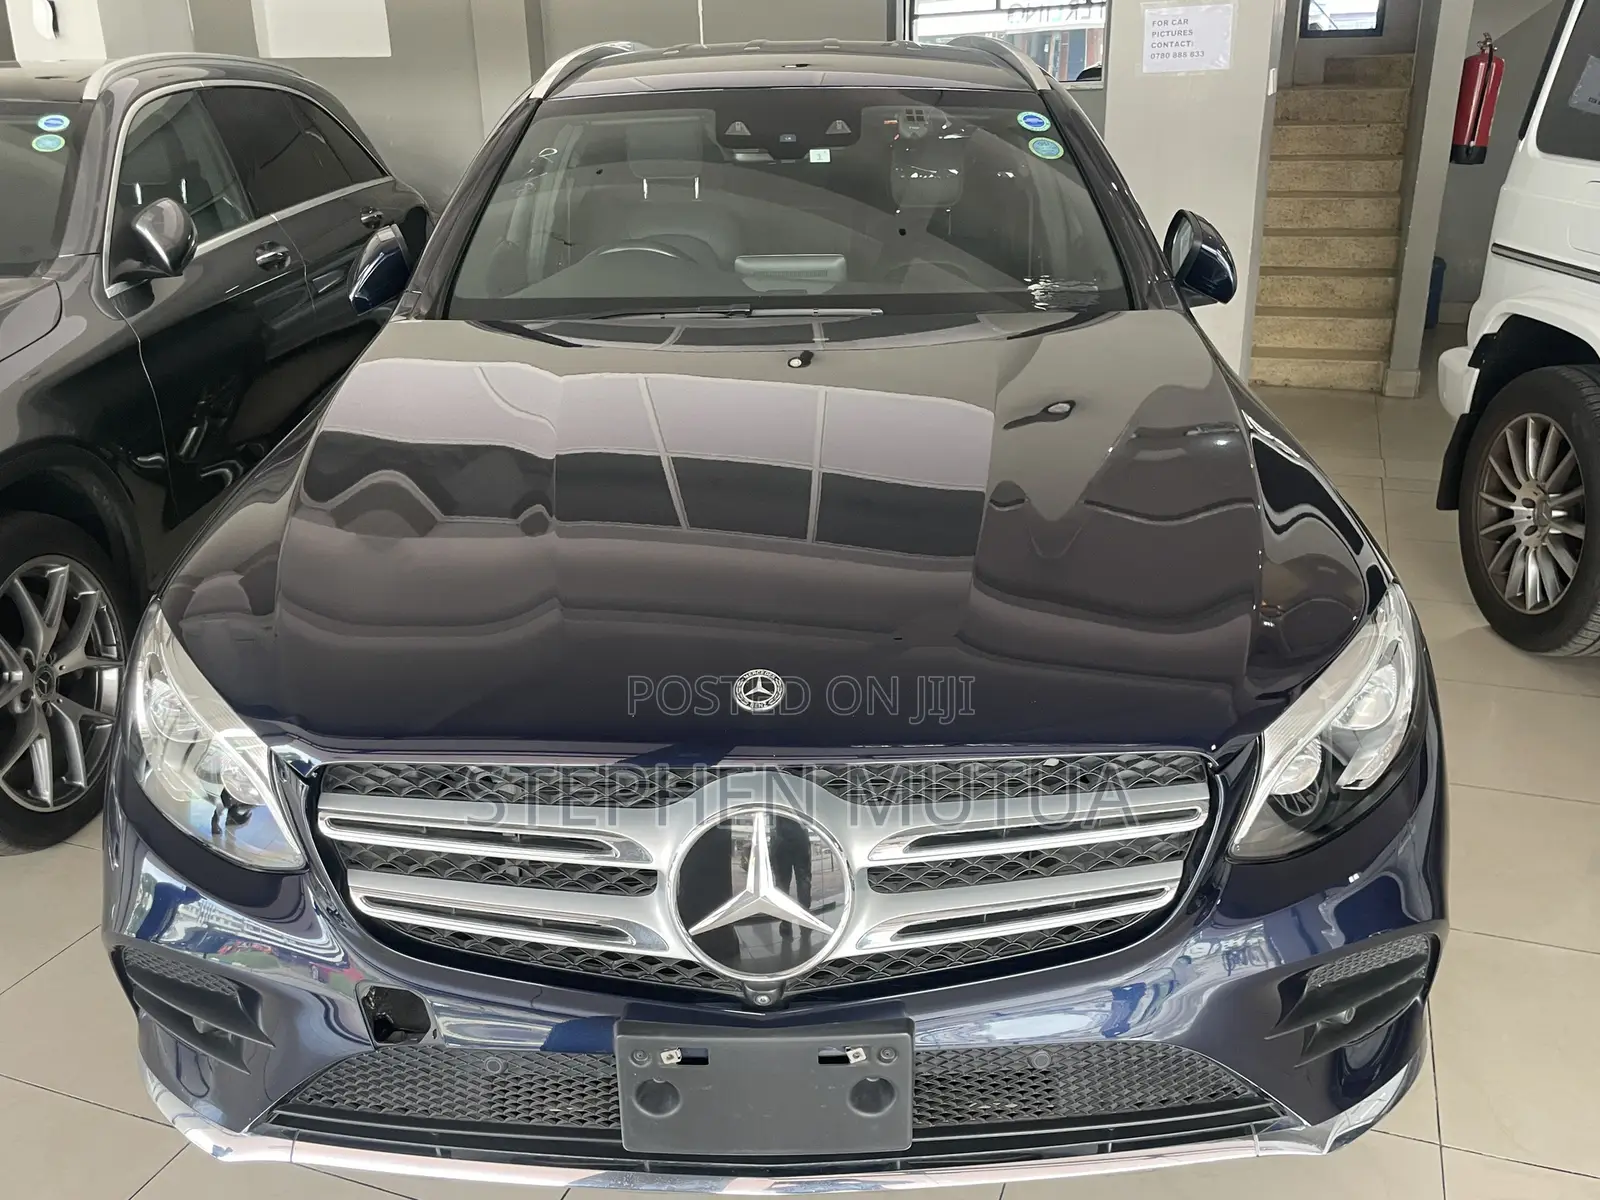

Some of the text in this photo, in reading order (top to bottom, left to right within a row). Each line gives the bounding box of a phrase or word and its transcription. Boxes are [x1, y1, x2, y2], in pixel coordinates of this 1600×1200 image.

[1151, 29, 1193, 38] PICTURES
[1151, 41, 1194, 49] CONTACT:
[1150, 52, 1171, 60] 0780
